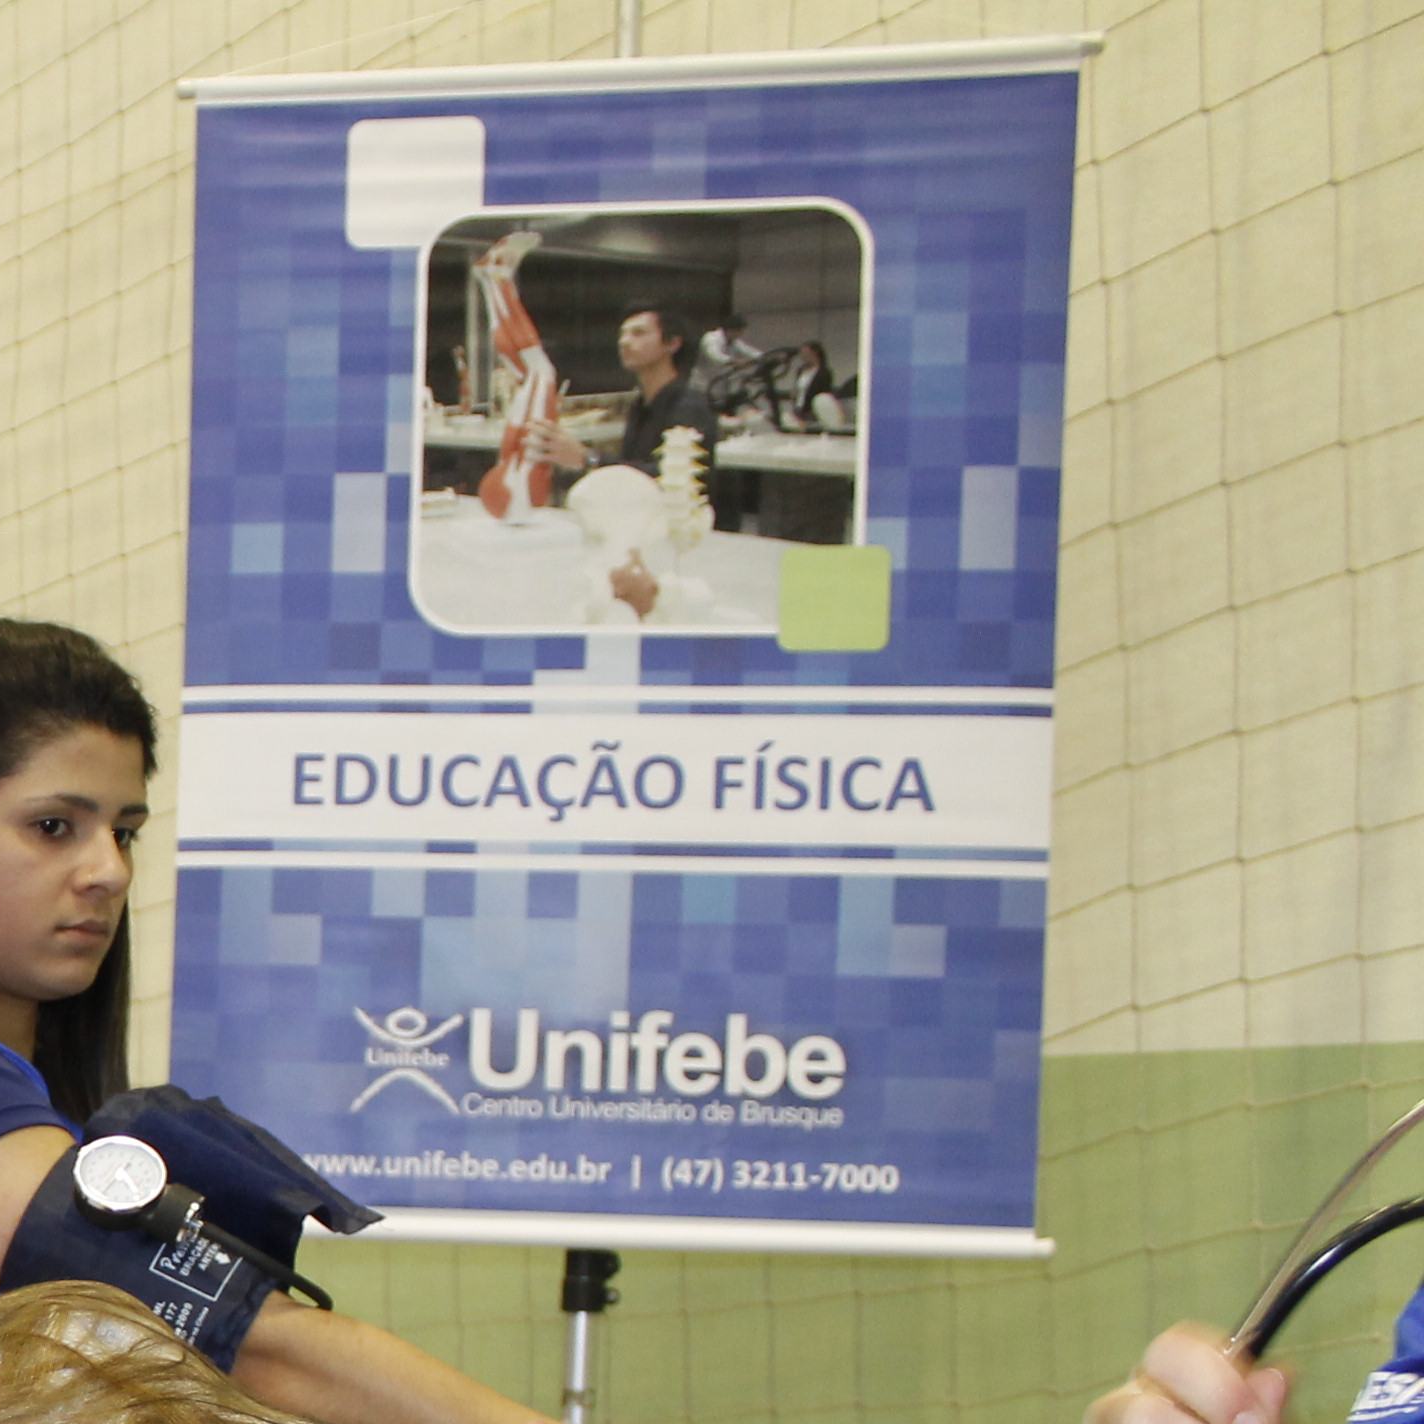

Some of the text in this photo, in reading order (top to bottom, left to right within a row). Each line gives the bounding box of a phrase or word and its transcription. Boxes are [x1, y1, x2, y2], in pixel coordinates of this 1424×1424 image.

[294, 740, 936, 822] EDUCAÇÃO FÍSICA
[364, 1046, 451, 1068] Unifebe
[469, 1006, 848, 1101] Unifebe
[461, 1091, 846, 1132] Centro Universitário de Brusque
[661, 1156, 724, 1194] (47)
[730, 1159, 901, 1194] 3211-7000
